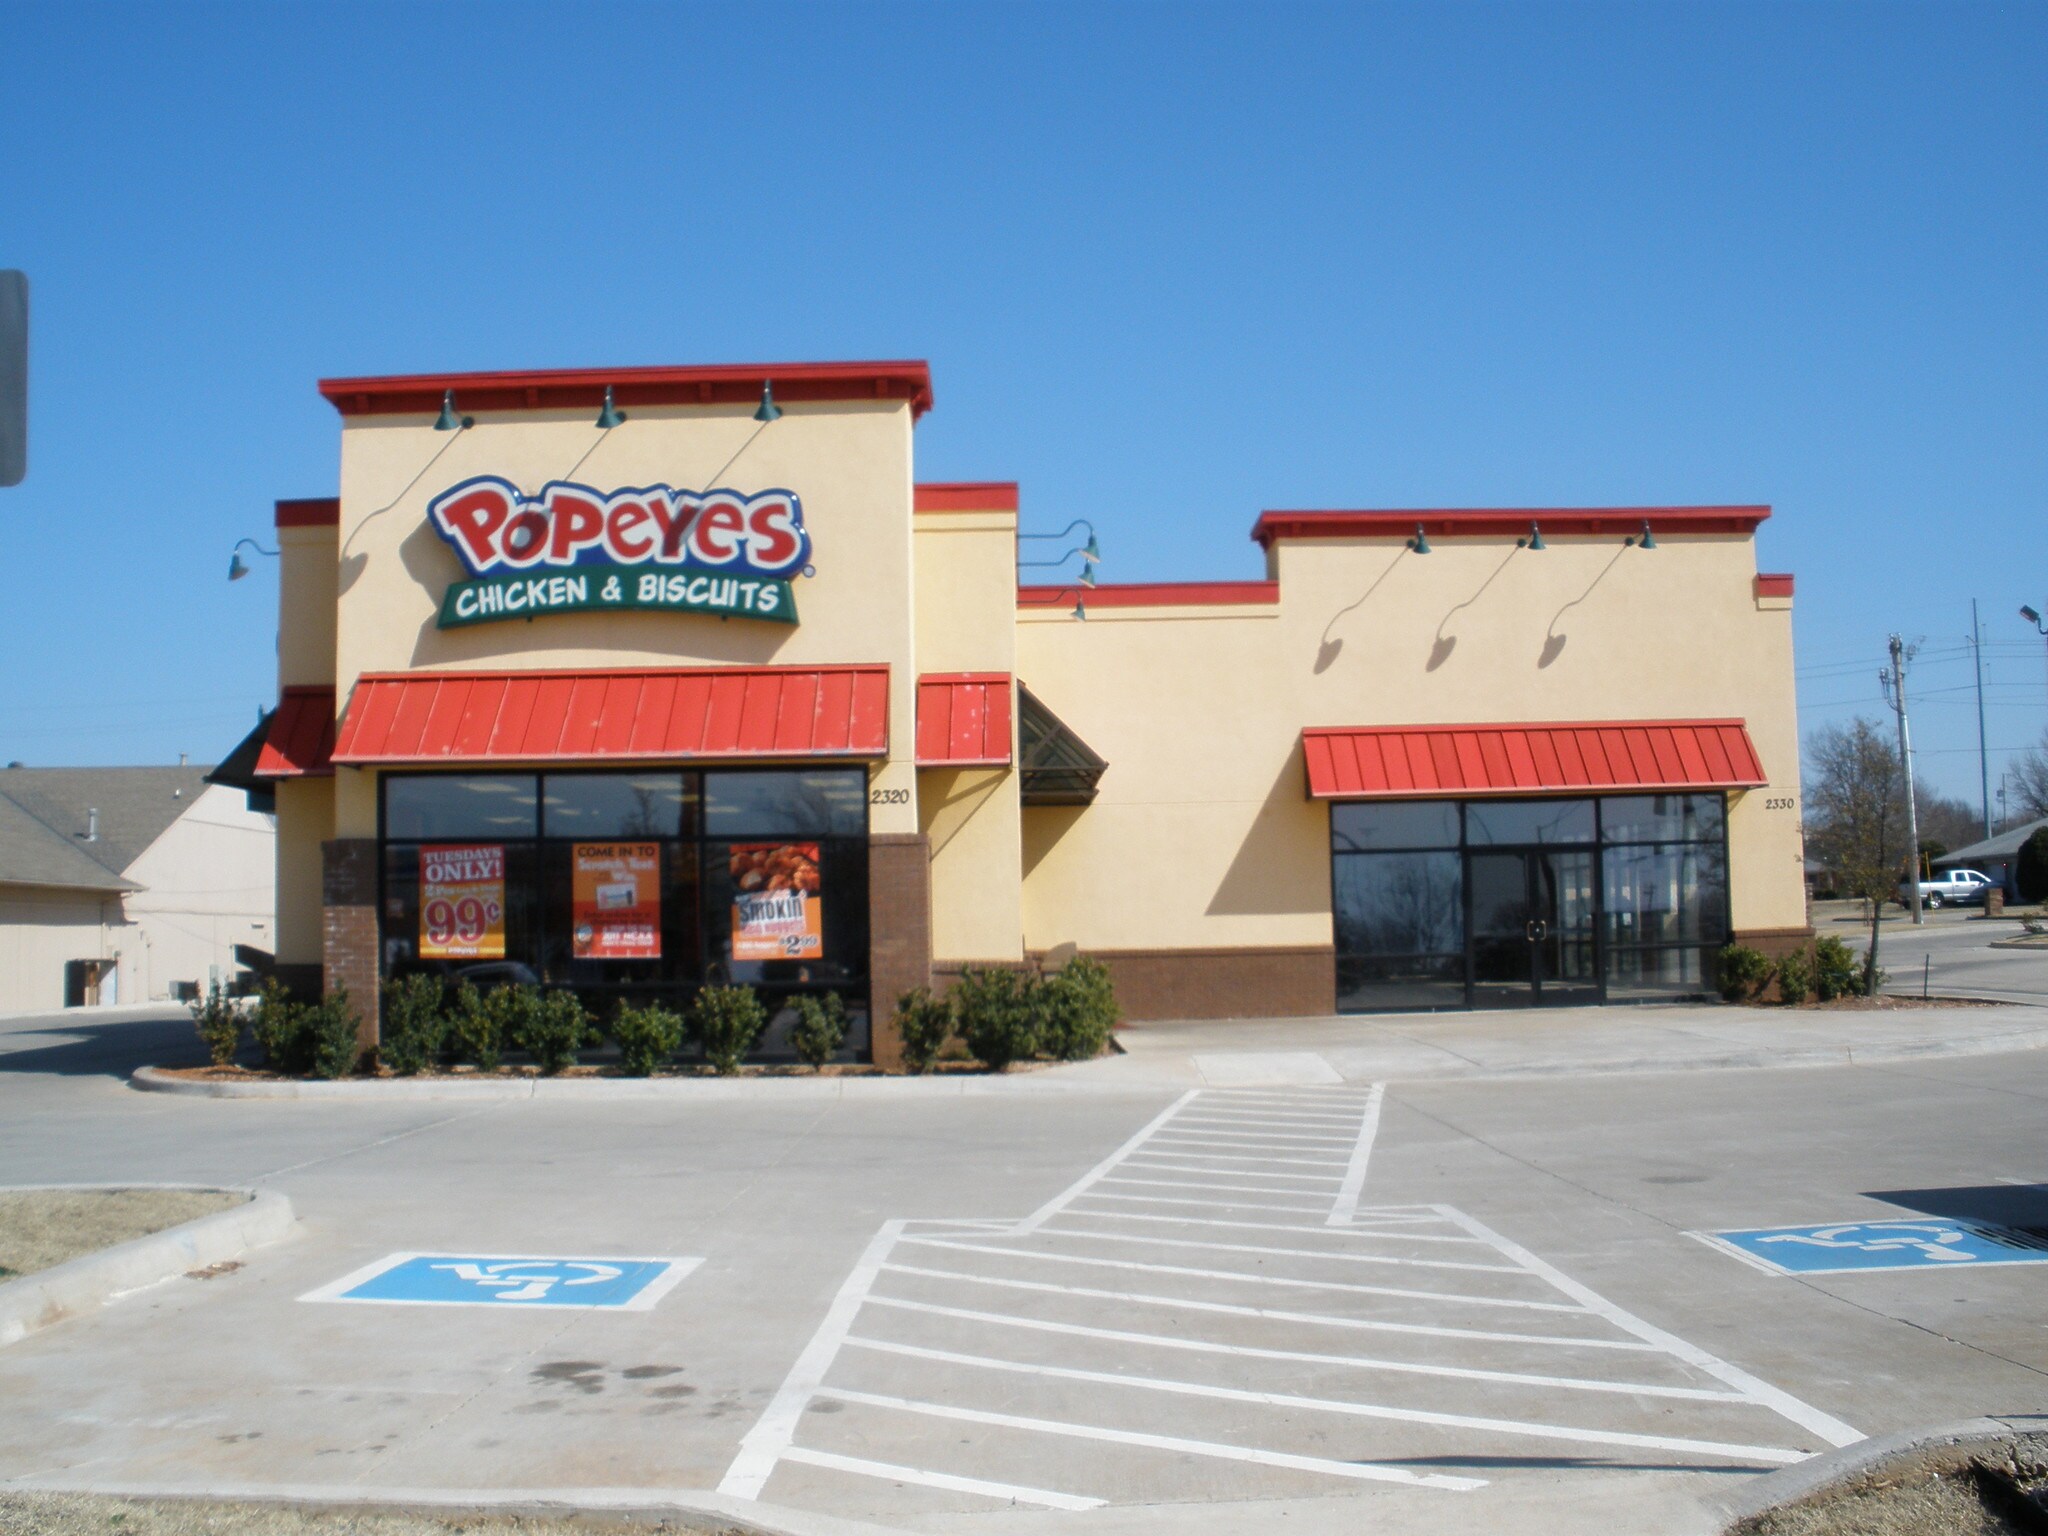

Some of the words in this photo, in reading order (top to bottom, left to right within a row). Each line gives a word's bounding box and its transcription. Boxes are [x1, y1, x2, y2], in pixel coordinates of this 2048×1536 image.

[455, 576, 588, 618] CHICKEN
[600, 575, 622, 602] &
[637, 574, 780, 612] BISCUITS
[871, 788, 910, 804] 2320
[1765, 797, 1795, 810] 2330
[424, 847, 502, 864] TUESDAYS
[578, 846, 615, 858] COME
[618, 846, 633, 857] IN
[638, 846, 656, 857] TO
[425, 860, 502, 882] ONLY!
